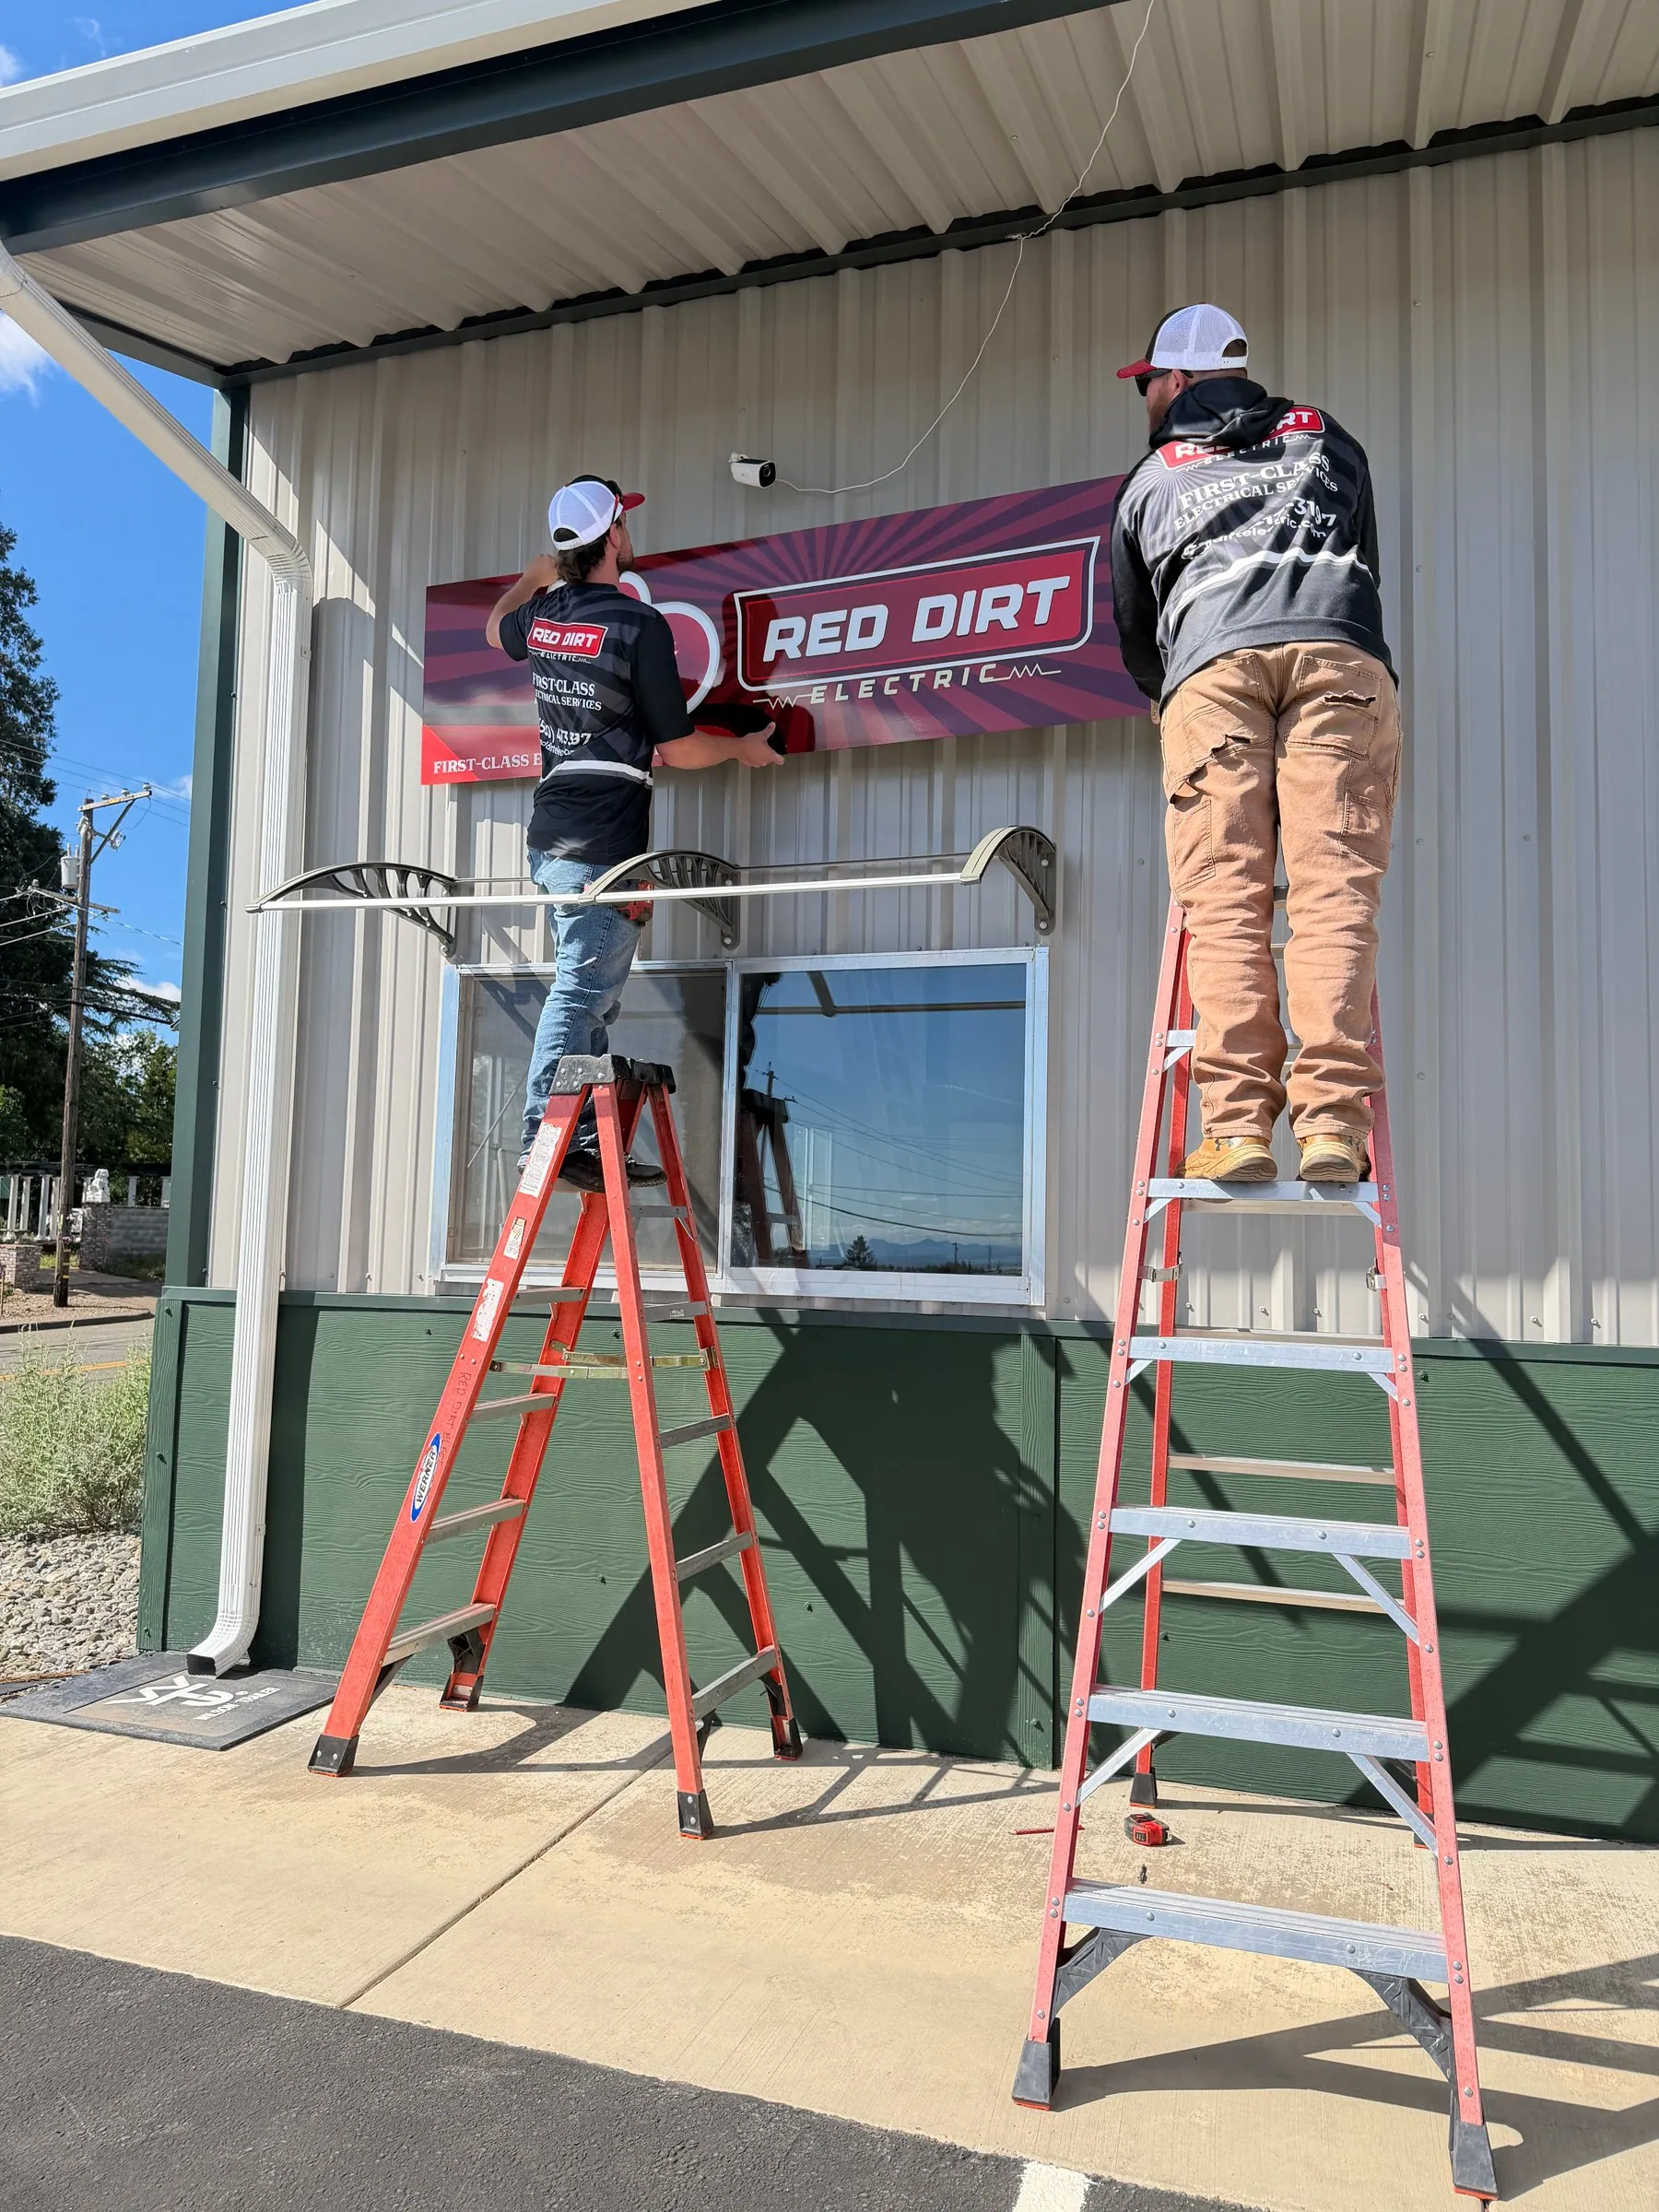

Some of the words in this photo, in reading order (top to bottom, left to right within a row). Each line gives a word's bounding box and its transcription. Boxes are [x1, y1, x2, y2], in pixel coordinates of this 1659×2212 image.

[1175, 442, 1230, 459] RE
[1270, 411, 1312, 434] RT
[1178, 452, 1330, 509] FIRST-CLASS
[1173, 484, 1274, 531] ELECTRICAL
[532, 627, 560, 645] RED
[561, 629, 598, 648] DIRT
[762, 604, 888, 662] RED
[912, 575, 1070, 642] DIRT
[809, 663, 998, 704] ELECTRIC
[433, 754, 529, 774] FIRST-CLASS
[456, 1371, 472, 1396] RED
[445, 1401, 462, 1430] DIRT
[416, 1451, 436, 1503] WERNER
